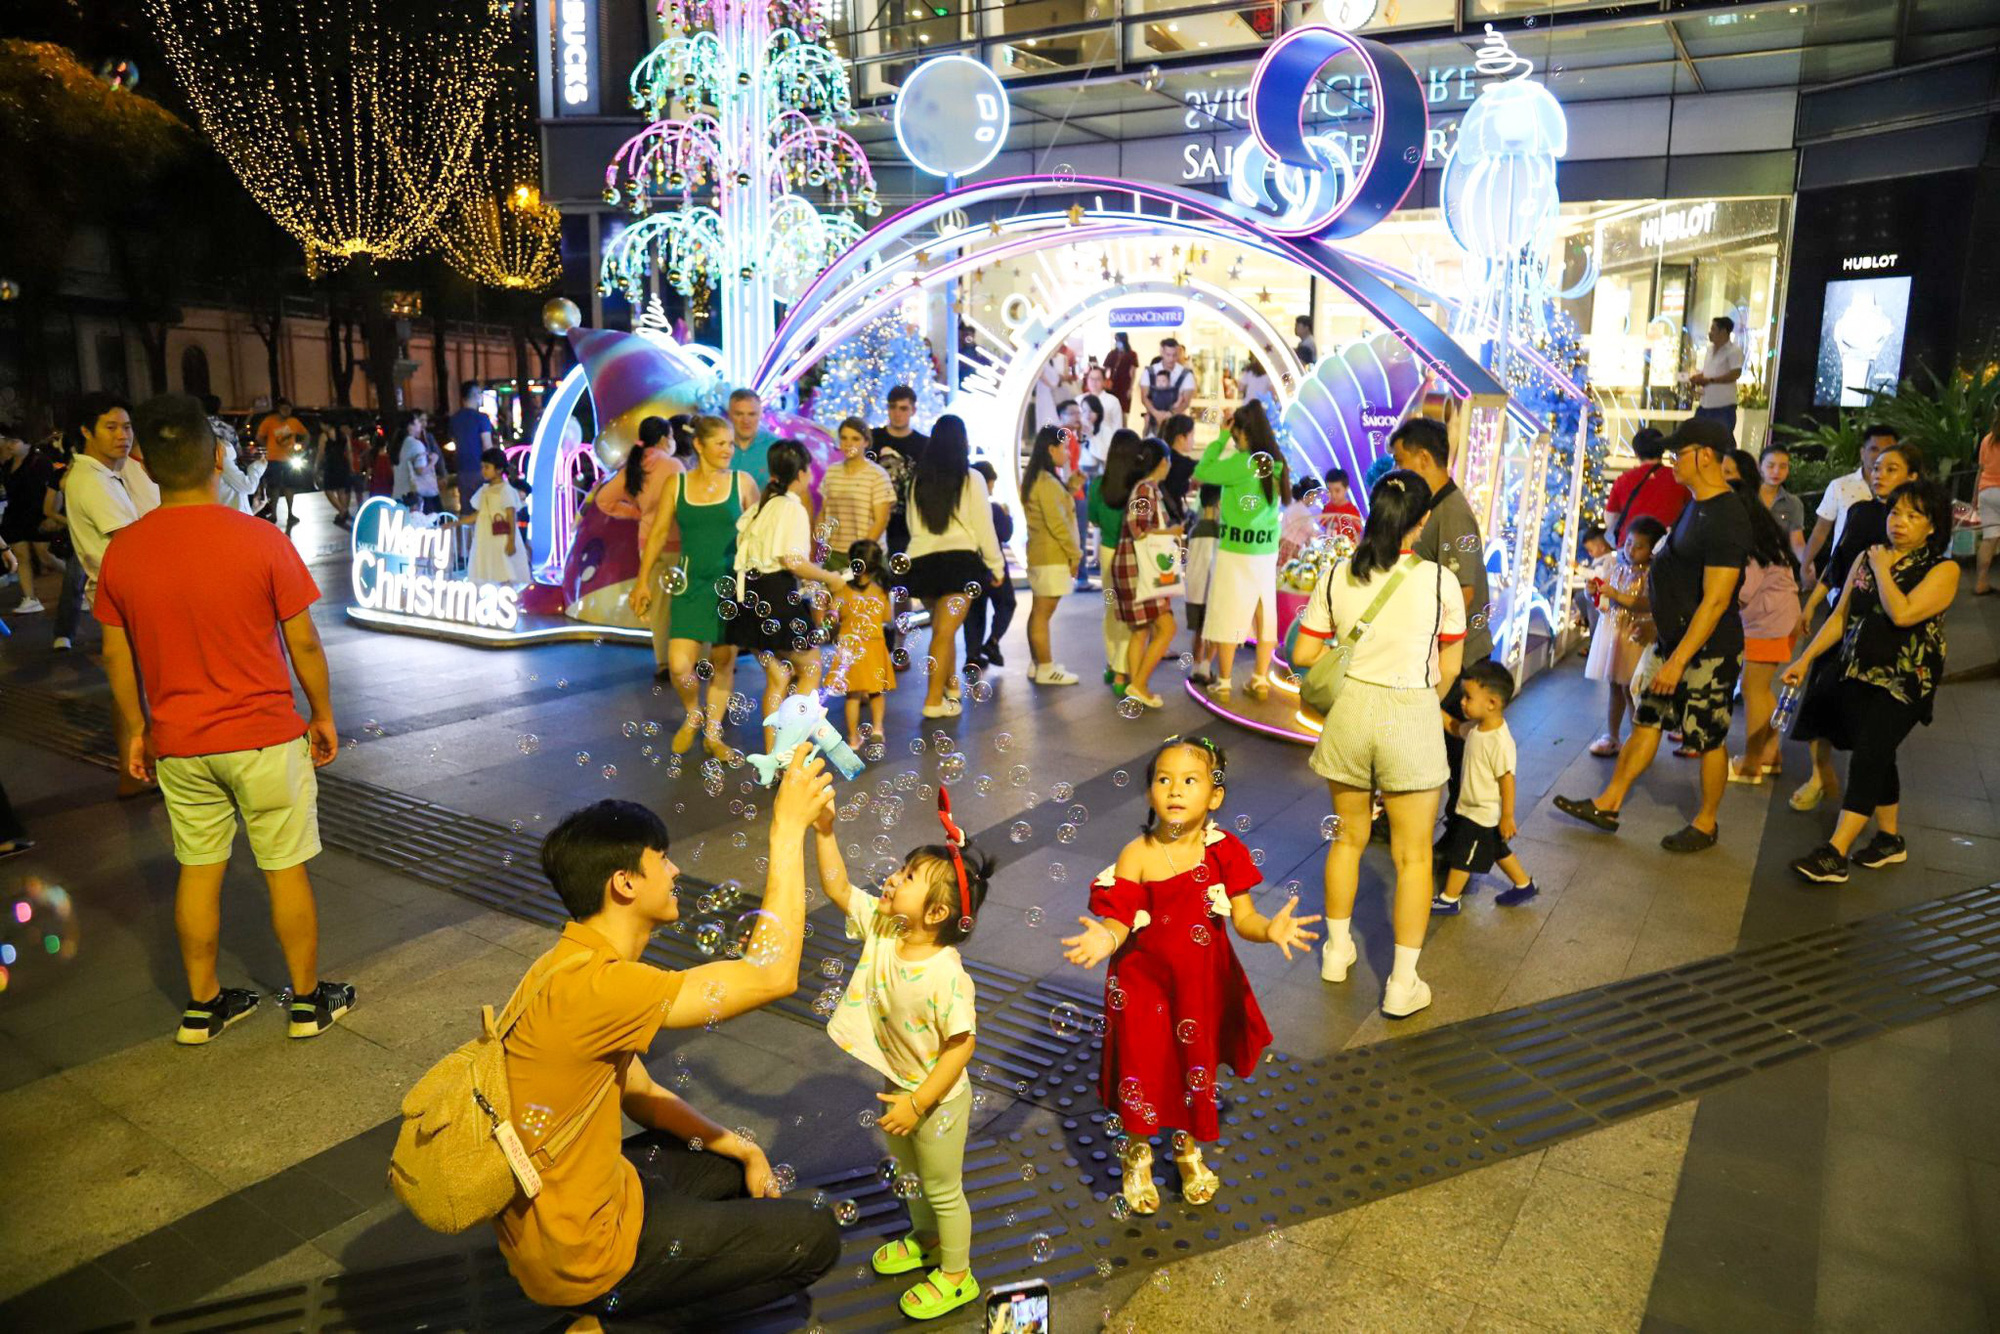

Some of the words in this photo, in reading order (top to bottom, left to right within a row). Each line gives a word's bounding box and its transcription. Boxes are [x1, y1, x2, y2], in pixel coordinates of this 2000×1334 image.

[562, 0, 588, 104] BUCKS
[1640, 202, 1716, 248] HUBLOT
[1842, 254, 1898, 270] HUBLOT
[377, 507, 452, 570] Merry
[352, 549, 518, 630] Christmas
